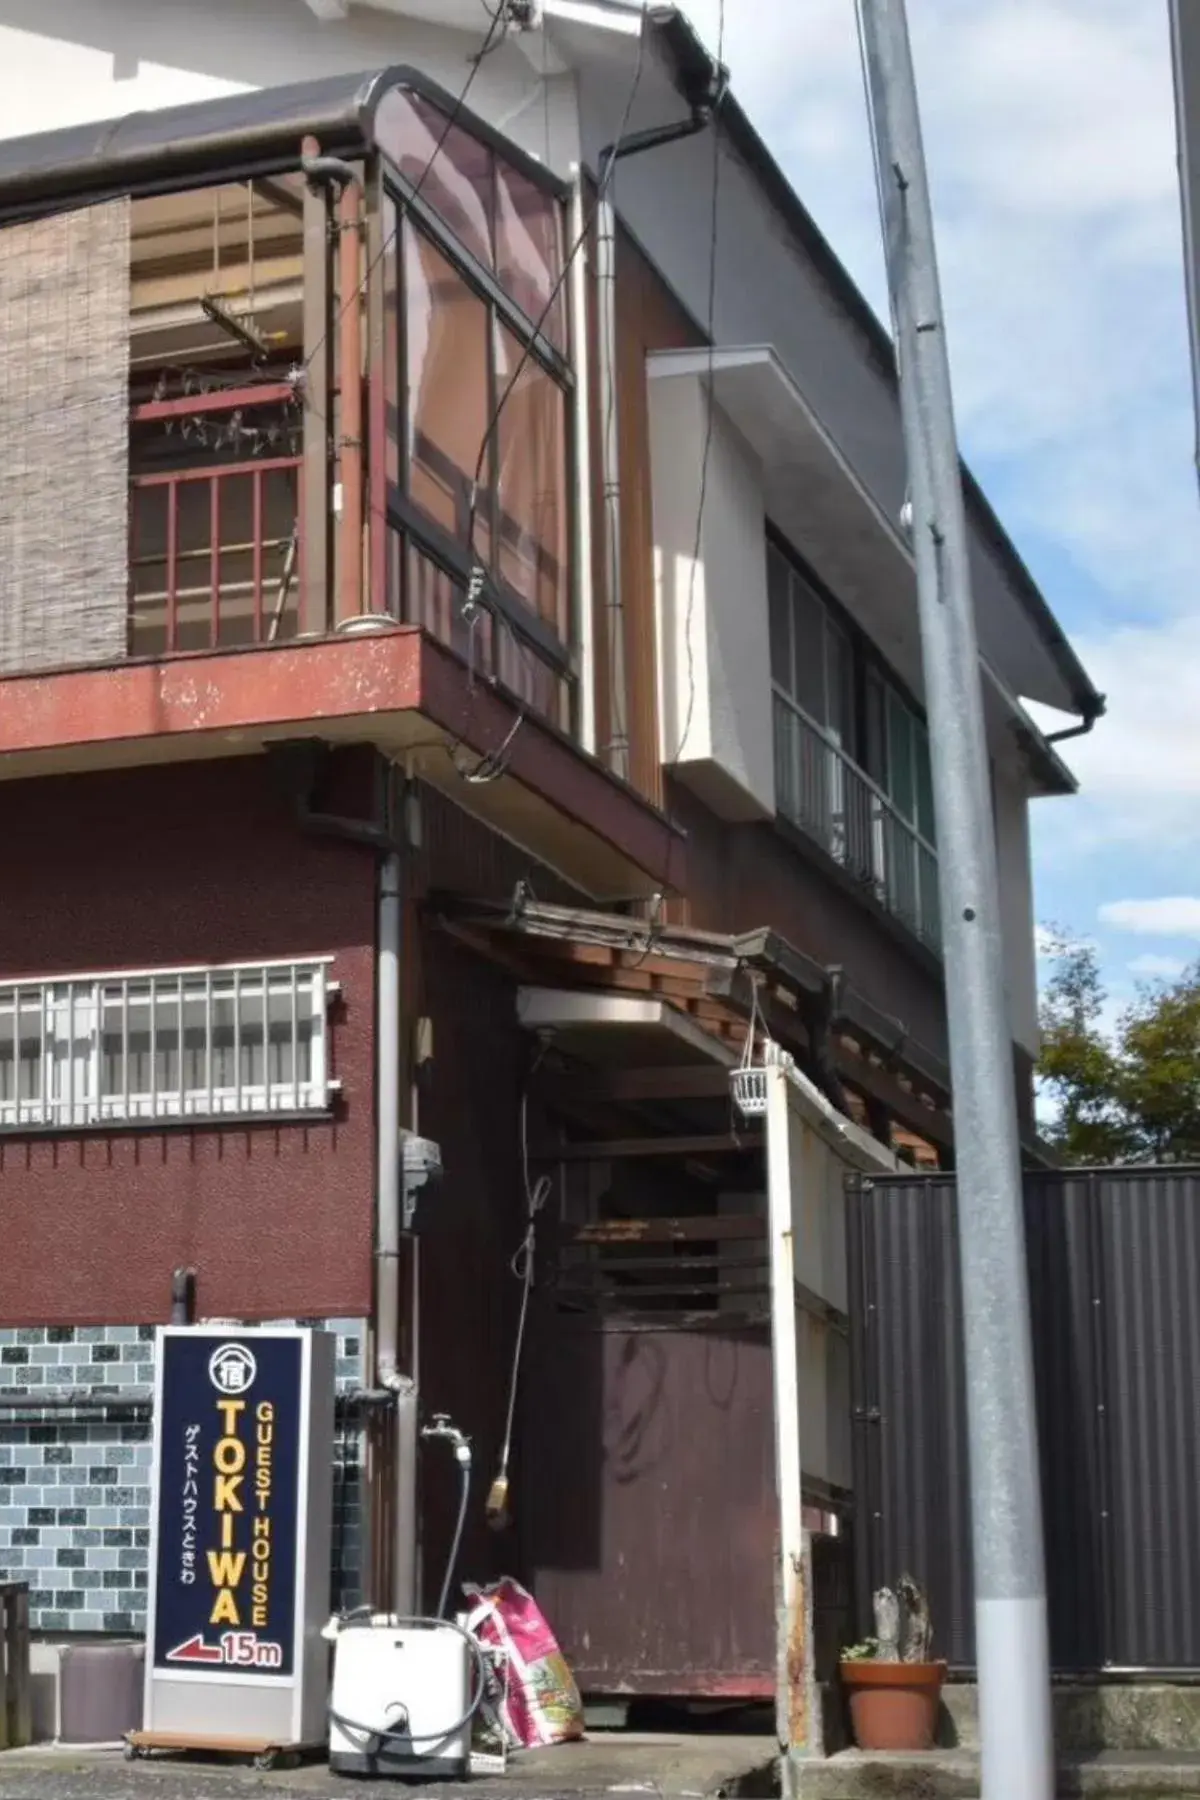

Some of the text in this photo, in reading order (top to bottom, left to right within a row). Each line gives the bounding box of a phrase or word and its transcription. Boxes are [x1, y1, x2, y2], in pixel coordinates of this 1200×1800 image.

[180, 1424, 200, 1585] ゲストハウスときわ
[207, 1400, 246, 1625] TOKIWA
[251, 1402, 274, 1627] GUEST HOUSE
[221, 1632, 282, 1667] 15m
